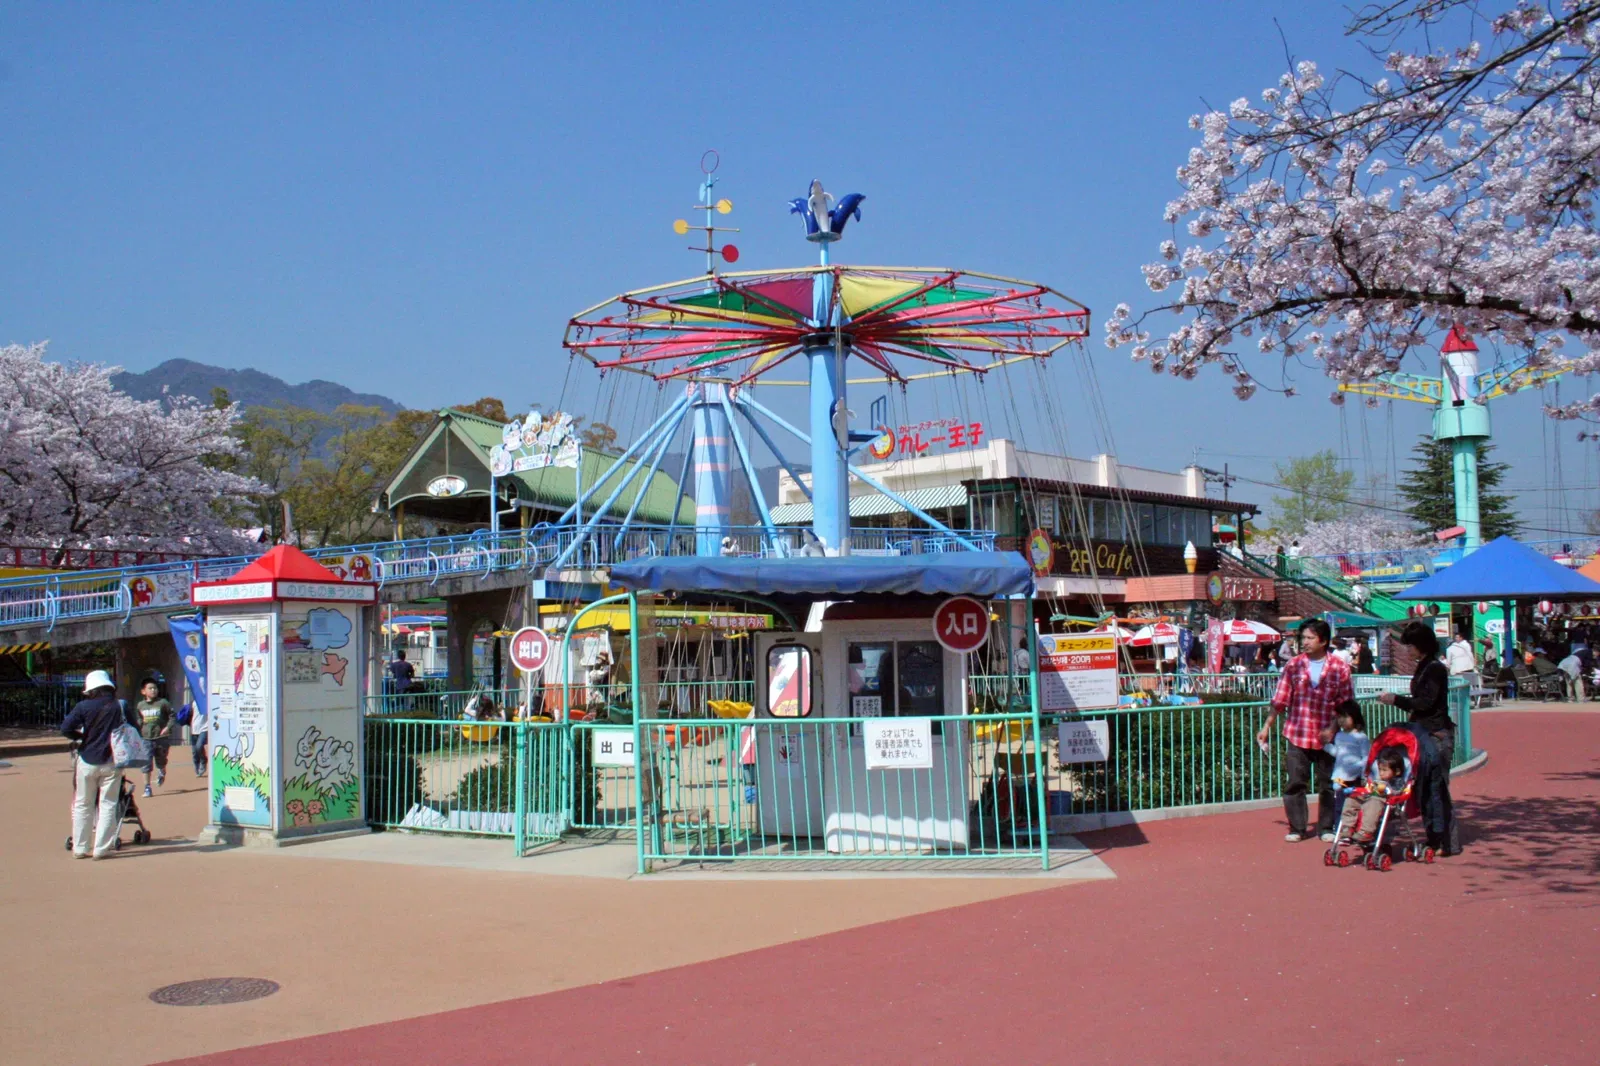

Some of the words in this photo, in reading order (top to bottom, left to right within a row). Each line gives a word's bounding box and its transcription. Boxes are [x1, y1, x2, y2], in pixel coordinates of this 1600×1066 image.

[898, 422, 984, 453] カレー王子
[945, 612, 978, 635] 入口
[518, 640, 542, 659] 出口
[1060, 639, 1112, 650] チェーンタワー
[881, 728, 915, 738] 3才以下は
[600, 740, 634, 754] 出口
[880, 749, 919, 760] 乗れません。
